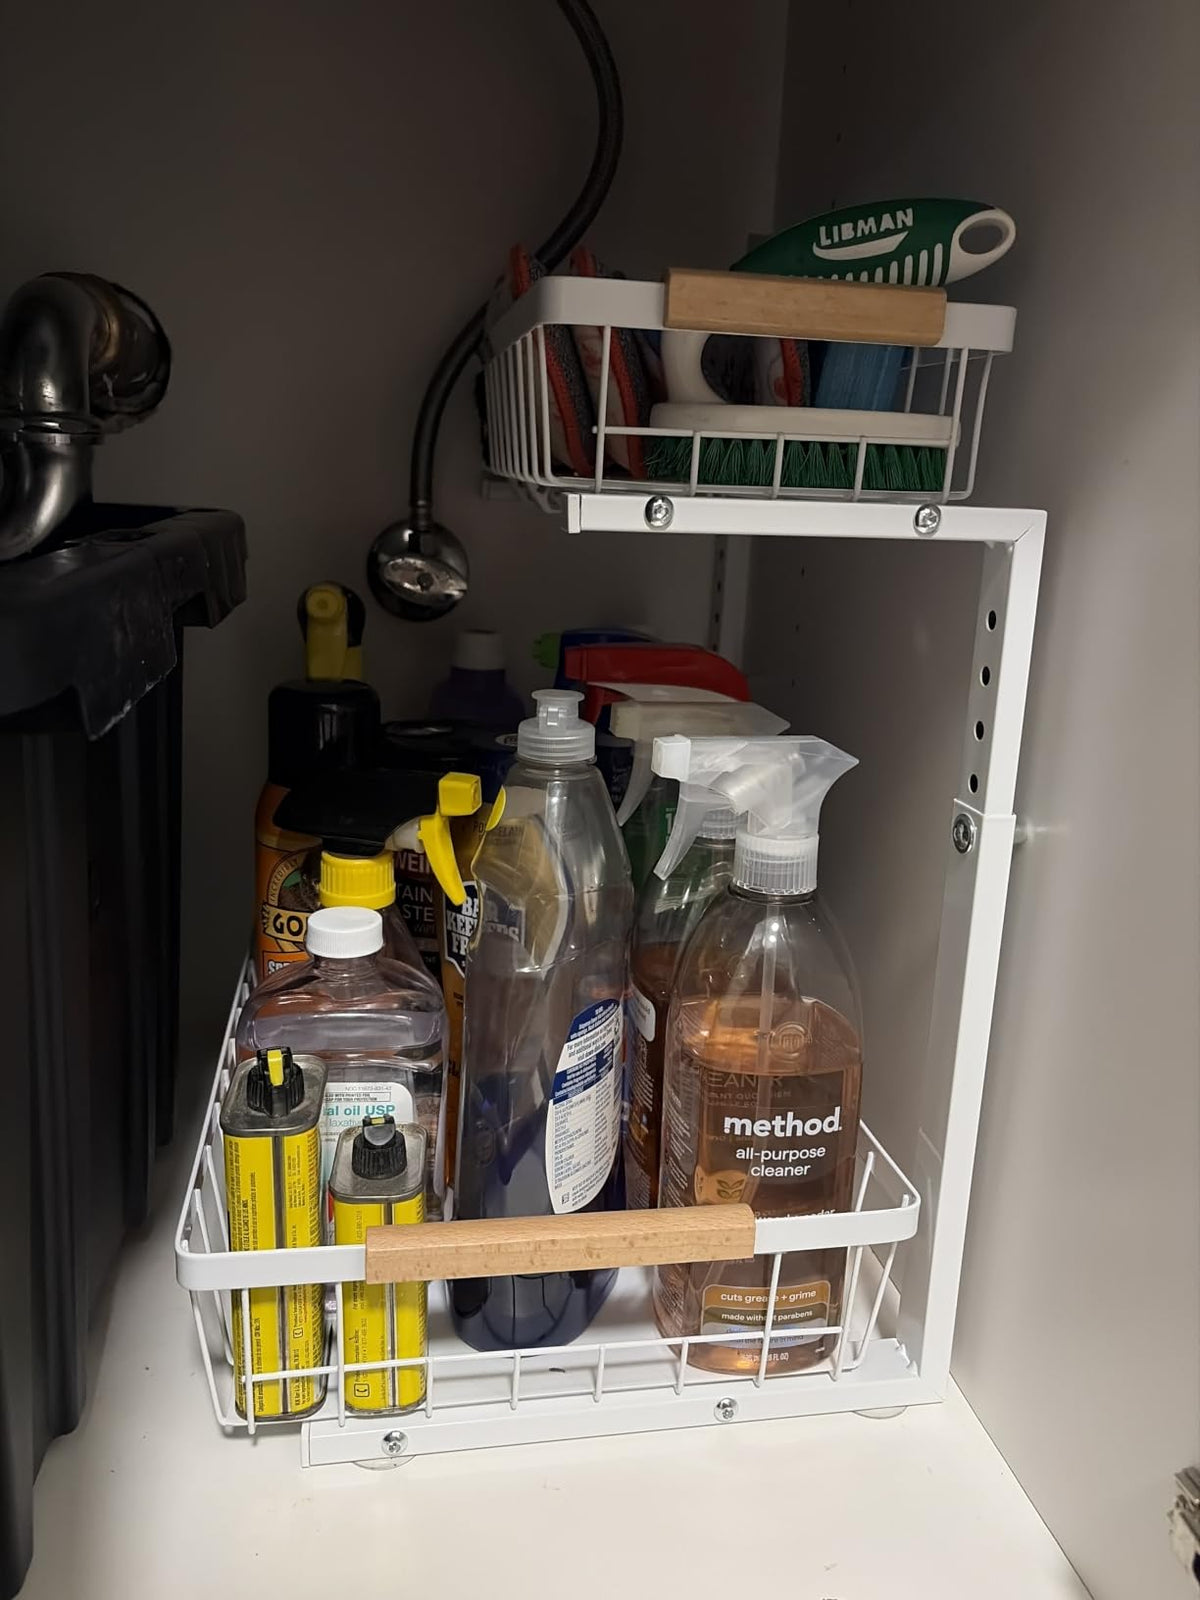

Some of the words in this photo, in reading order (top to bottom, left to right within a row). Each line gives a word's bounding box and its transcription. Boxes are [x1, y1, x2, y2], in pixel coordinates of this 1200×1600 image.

[819, 207, 914, 247] LIBMAN
[344, 1105, 361, 1116] oil
[366, 1104, 396, 1117] USP
[735, 1145, 827, 1163] all-purpose
[750, 1162, 811, 1178] cleaner
[720, 1291, 743, 1303] cuts
[788, 1288, 817, 1304] grime
[721, 1311, 745, 1323] made
[777, 1309, 813, 1323] parabens
